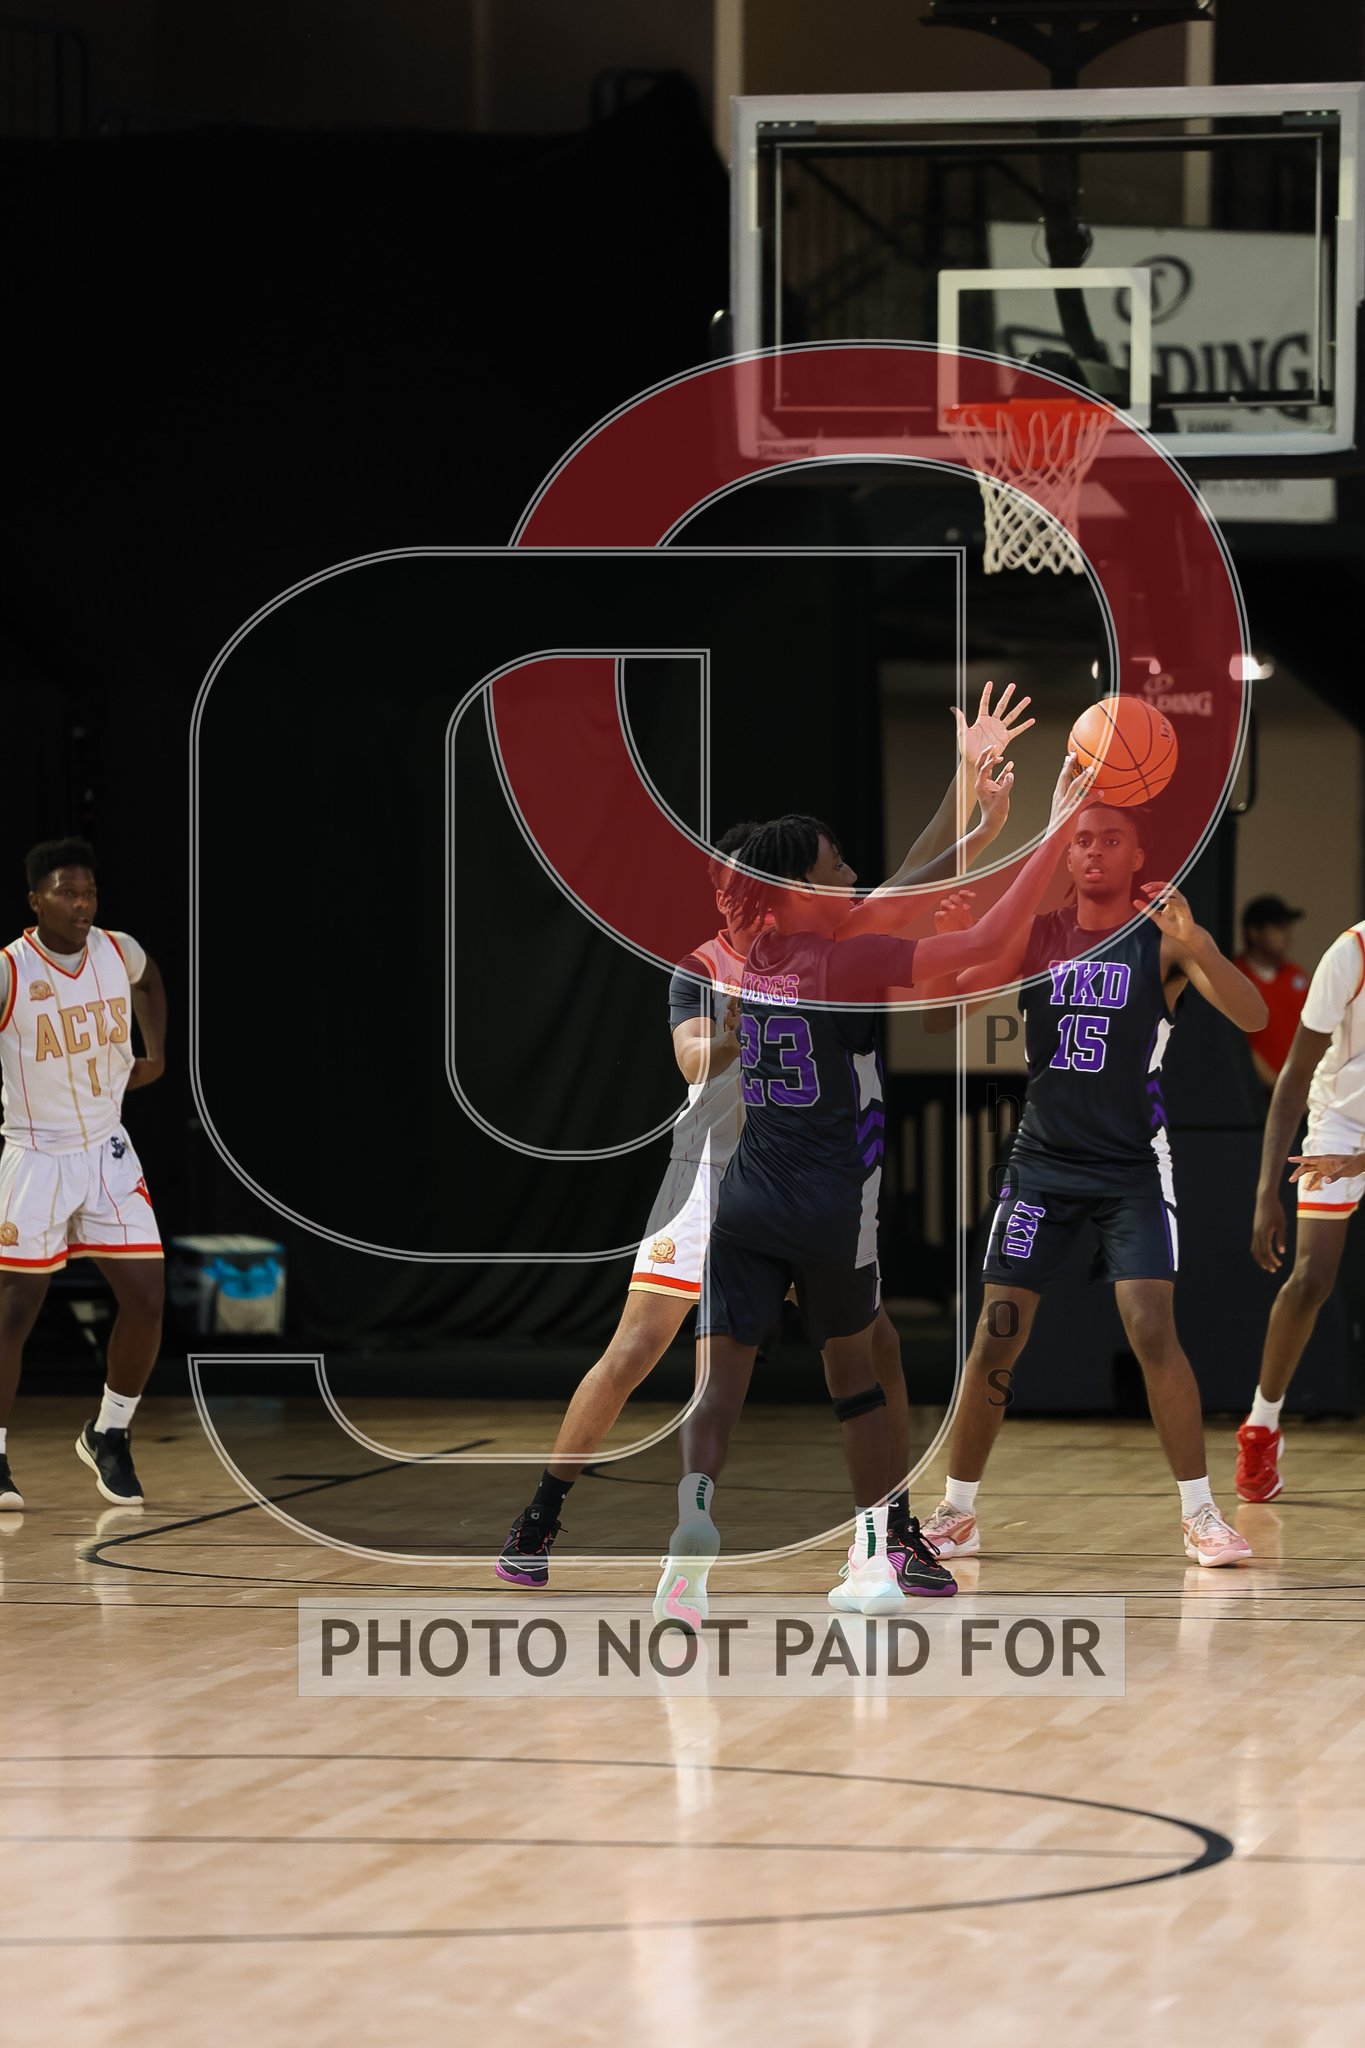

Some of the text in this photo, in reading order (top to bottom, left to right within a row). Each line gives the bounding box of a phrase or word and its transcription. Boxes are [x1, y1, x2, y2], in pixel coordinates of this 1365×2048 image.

[1048, 960, 1131, 1010] YKD
[36, 997, 129, 1062] ACTS
[1049, 1014, 1110, 1073] 15
[87, 1056, 102, 1097] 1
[1001, 1200, 1047, 1259] YKD
